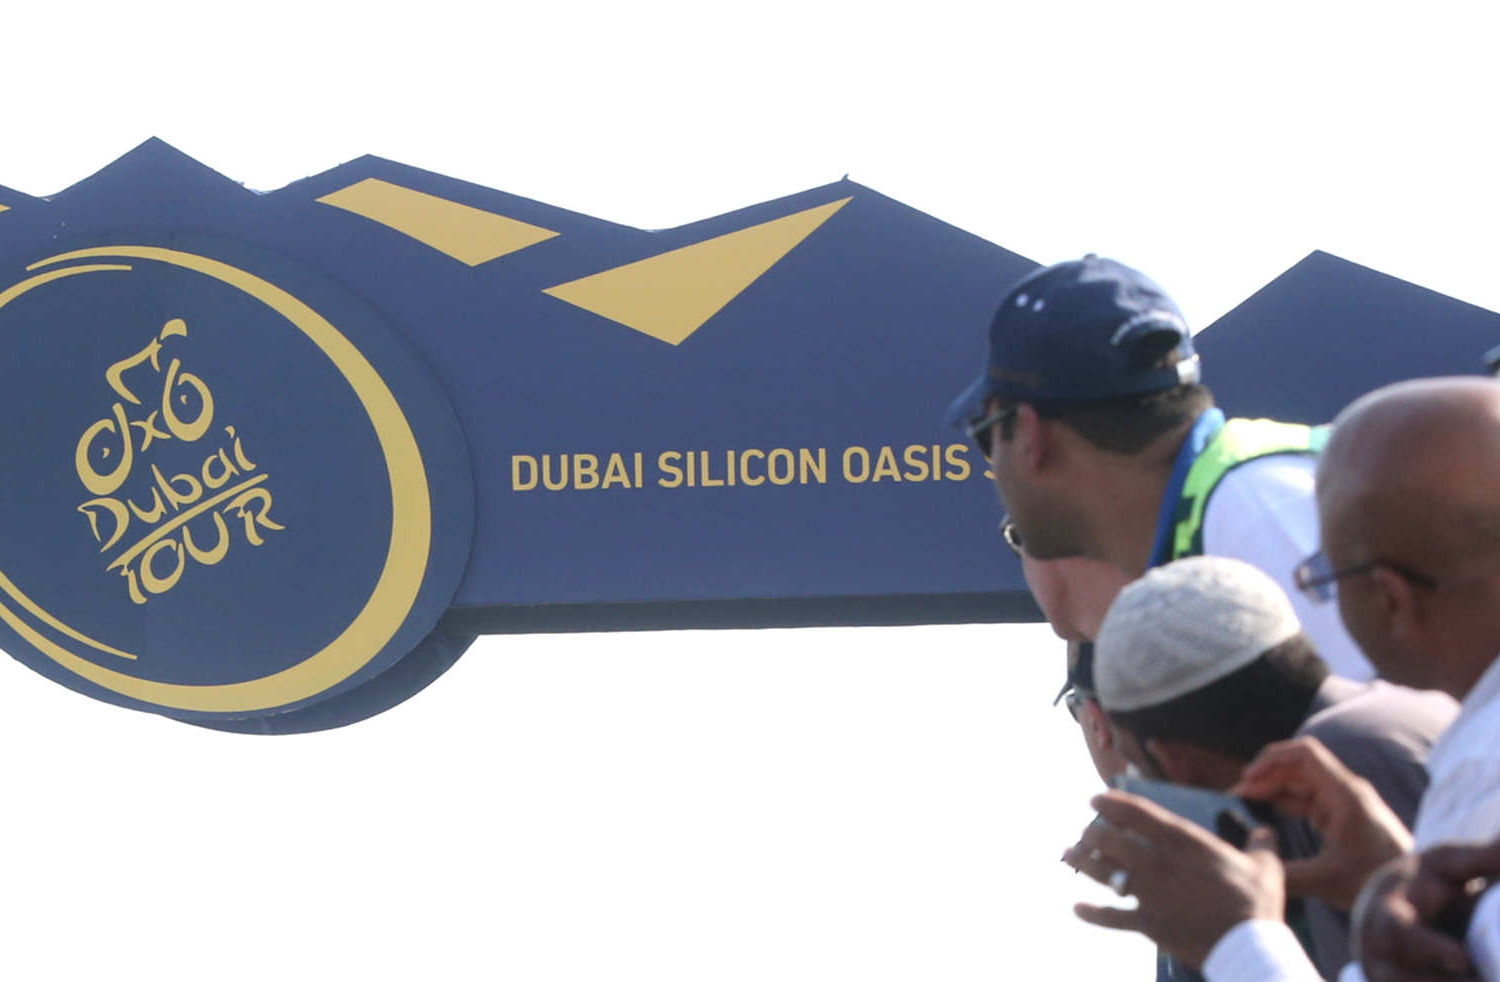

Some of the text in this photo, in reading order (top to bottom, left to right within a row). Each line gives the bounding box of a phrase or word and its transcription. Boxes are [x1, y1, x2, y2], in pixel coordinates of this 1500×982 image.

[77, 425, 257, 553] Dubai
[511, 453, 643, 491] DUBAI
[658, 448, 827, 487] SILICON
[842, 444, 970, 483] OASIS
[106, 474, 285, 604] TOUR
